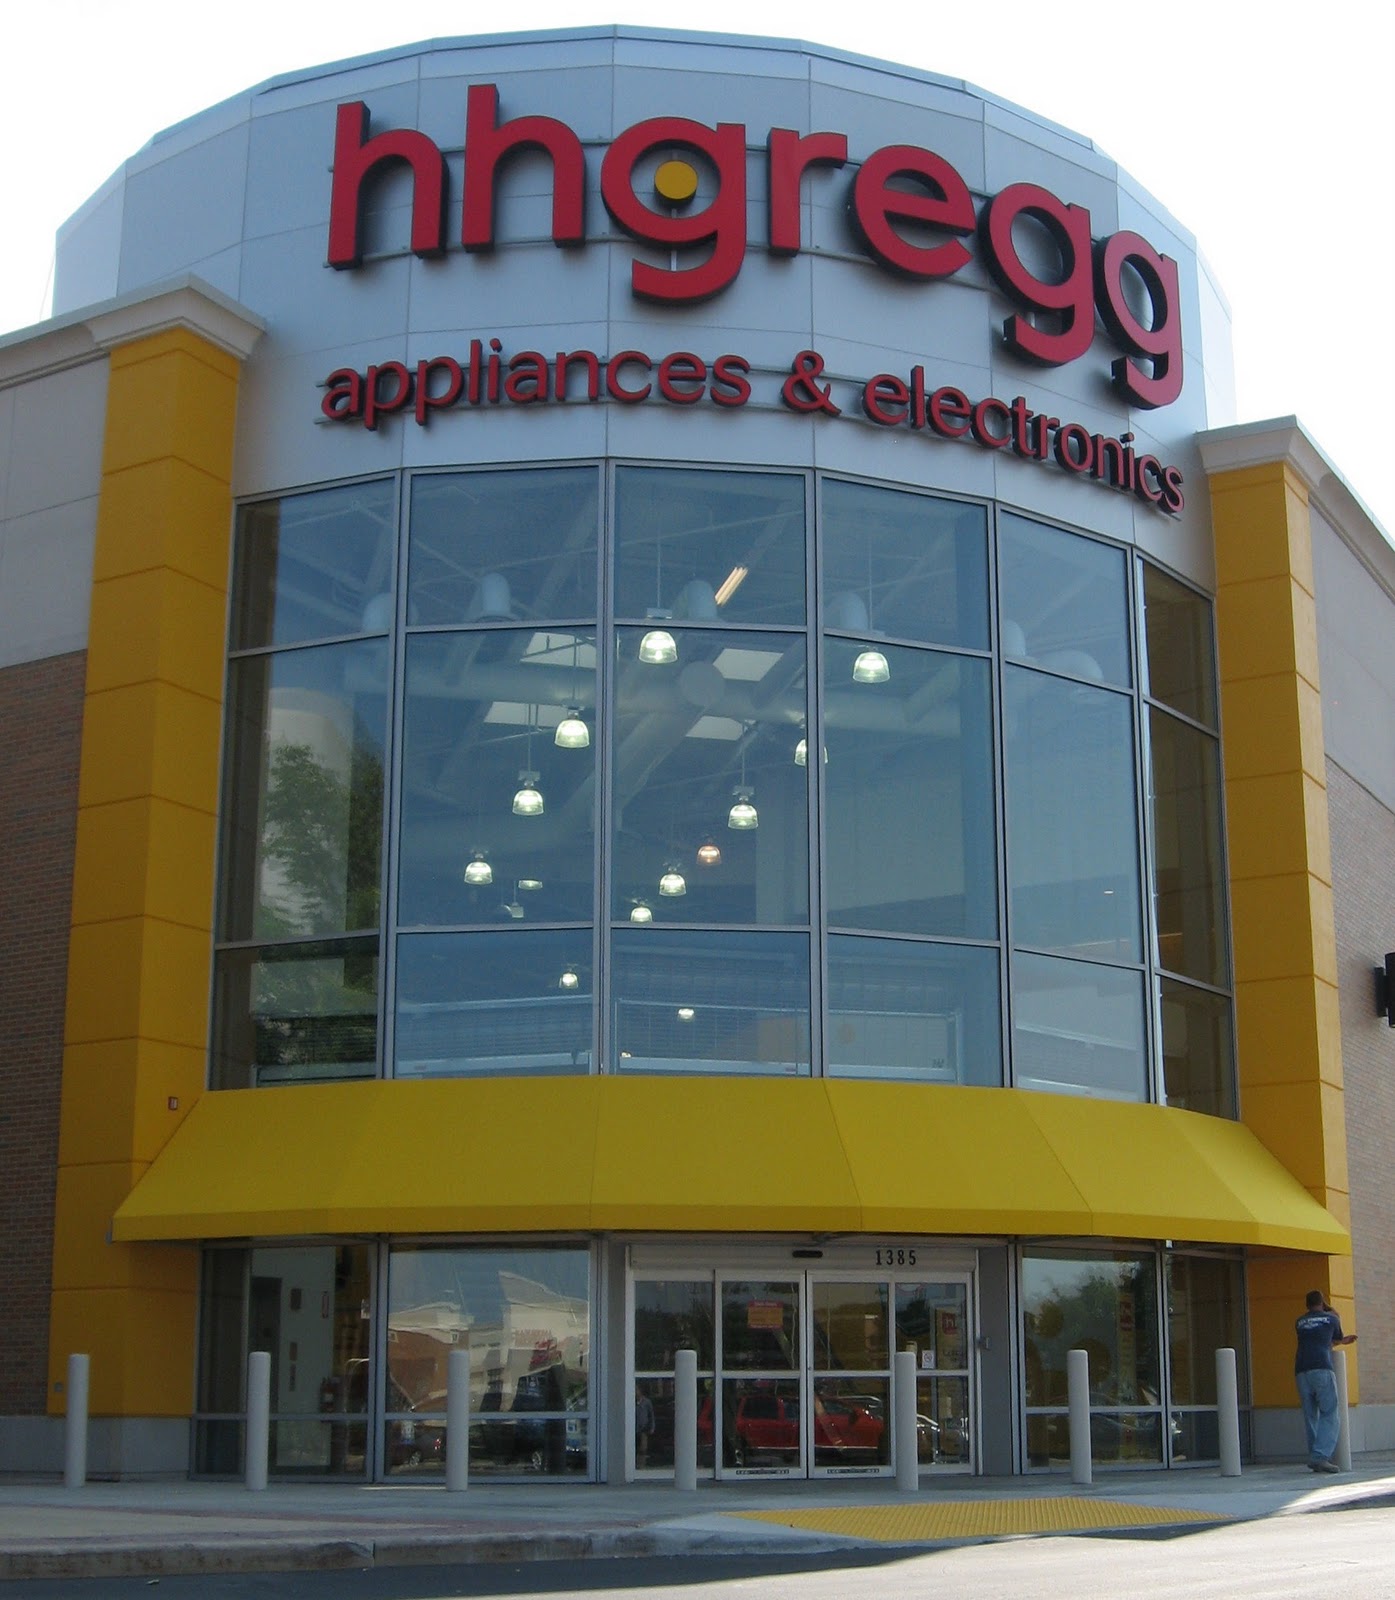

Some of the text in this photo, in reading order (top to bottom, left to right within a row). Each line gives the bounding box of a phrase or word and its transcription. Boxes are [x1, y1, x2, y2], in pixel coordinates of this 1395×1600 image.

[327, 84, 1184, 410] hhgregg
[321, 338, 1185, 514] appliances & electronics
[875, 1249, 916, 1266] 1385
